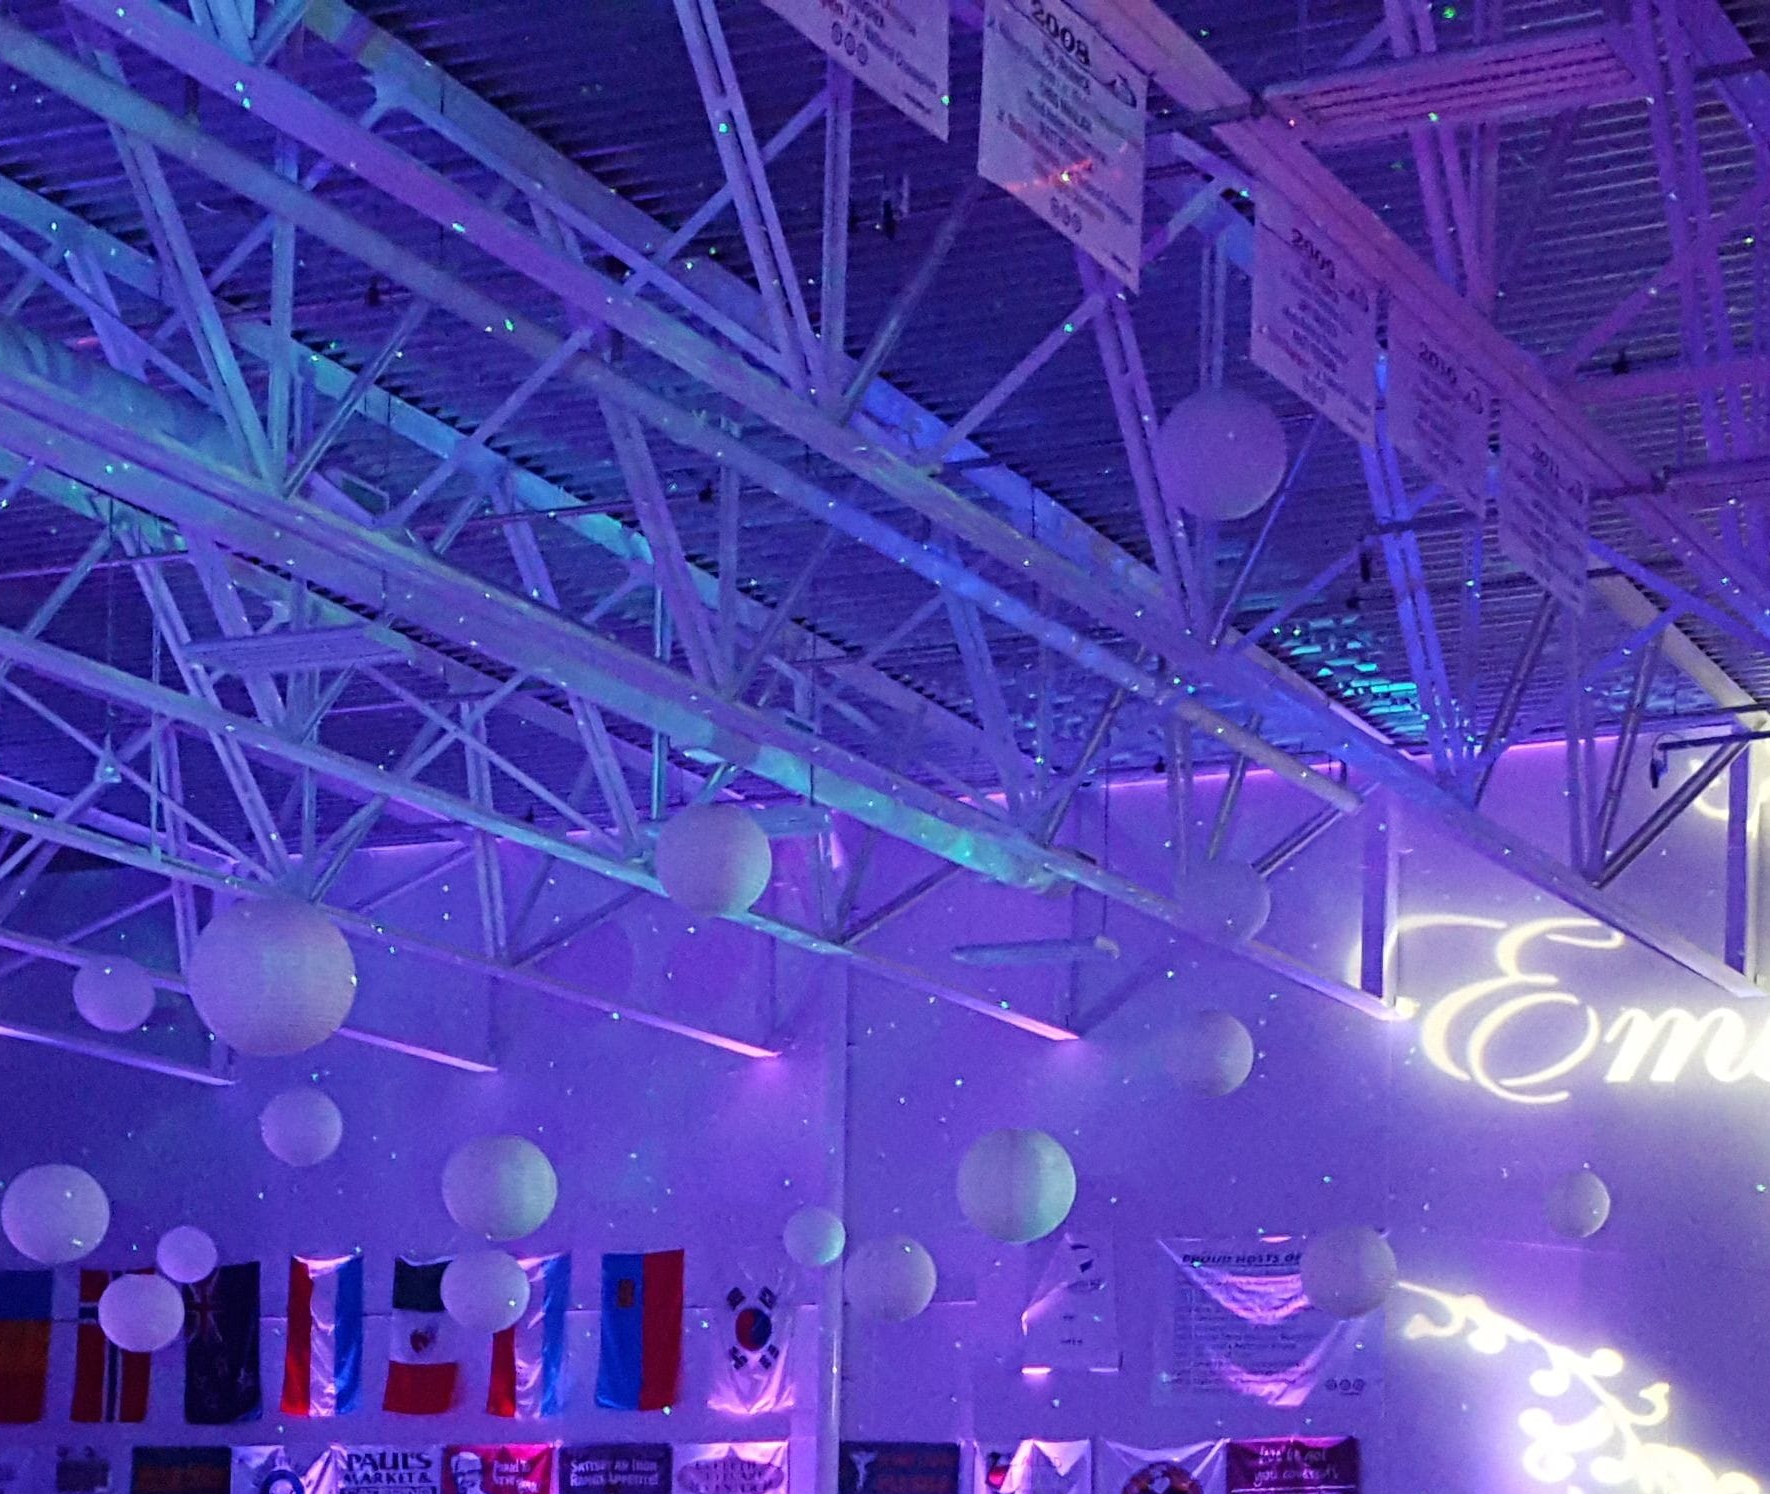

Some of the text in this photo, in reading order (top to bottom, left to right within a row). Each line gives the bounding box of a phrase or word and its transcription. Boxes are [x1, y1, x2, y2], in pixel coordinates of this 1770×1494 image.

[1031, 0, 1090, 66] 2008
[1236, 1253, 1280, 1264] HOSTS
[346, 1452, 433, 1471] PAUL'S
[343, 1472, 433, 1484] MARKET &
